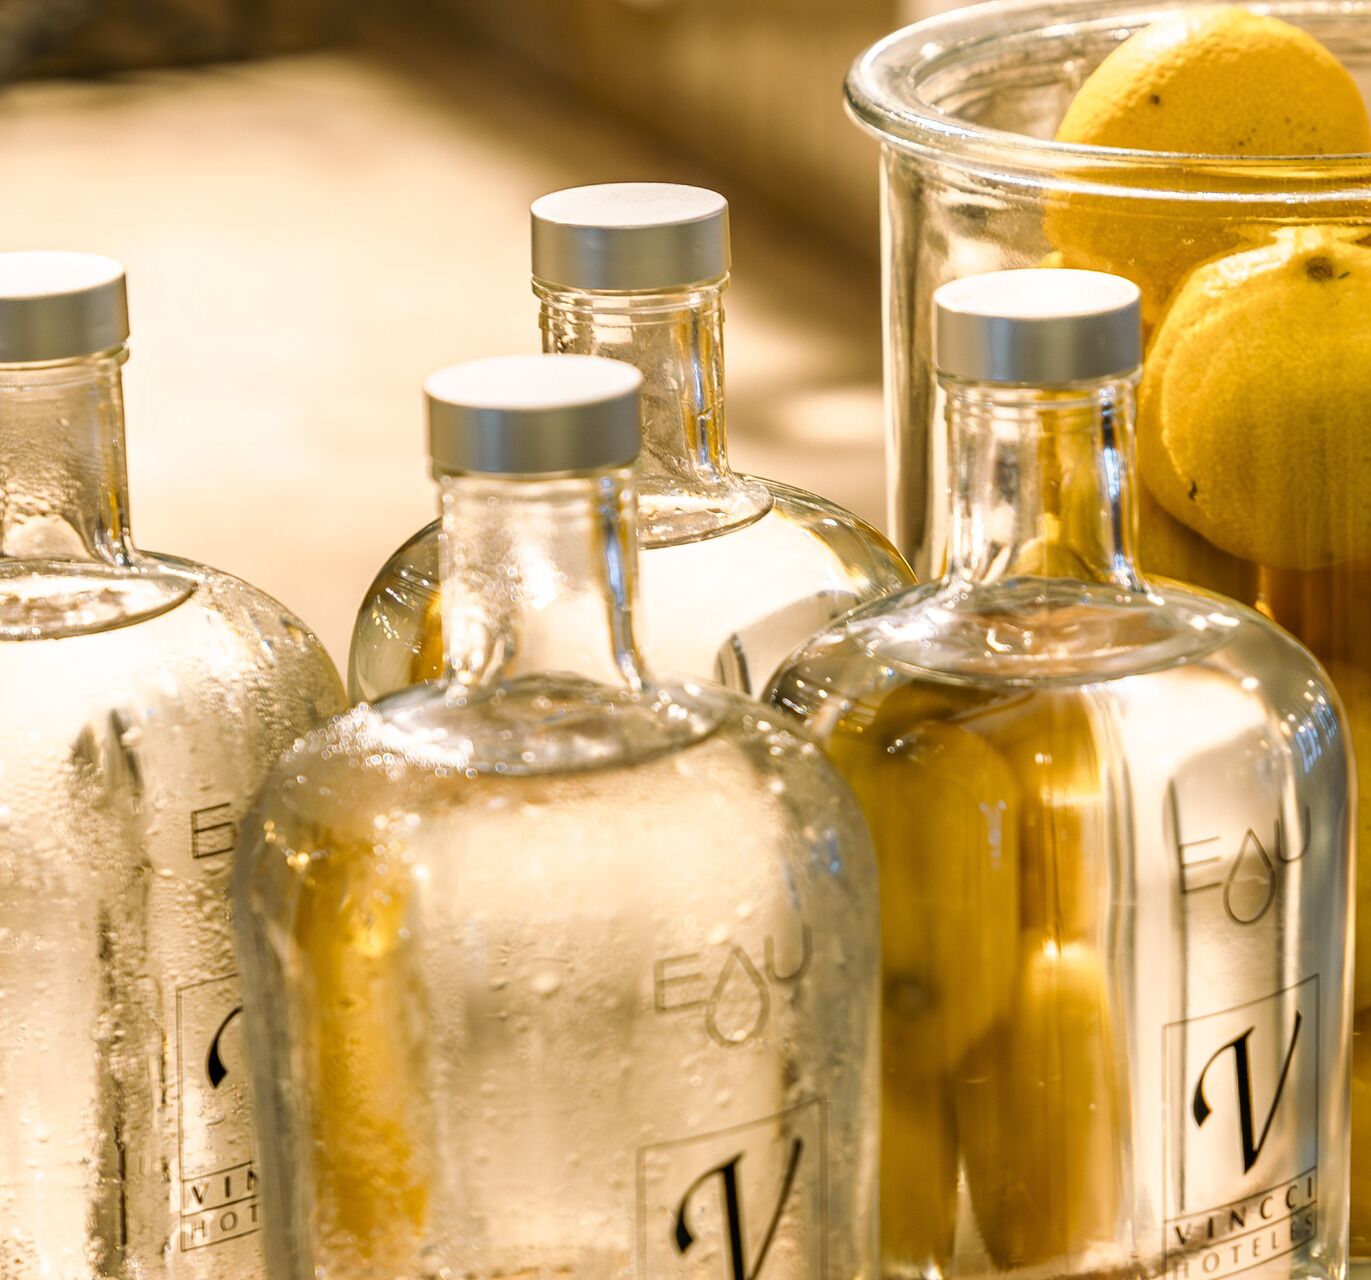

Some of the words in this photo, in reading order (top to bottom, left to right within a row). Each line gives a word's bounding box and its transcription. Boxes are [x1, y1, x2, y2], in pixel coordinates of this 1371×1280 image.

[1192, 1009, 1303, 1176] V
[192, 1168, 260, 1205] VIN
[1174, 1177, 1312, 1245] VINCCI
[1172, 1213, 1313, 1280] HOTELES
